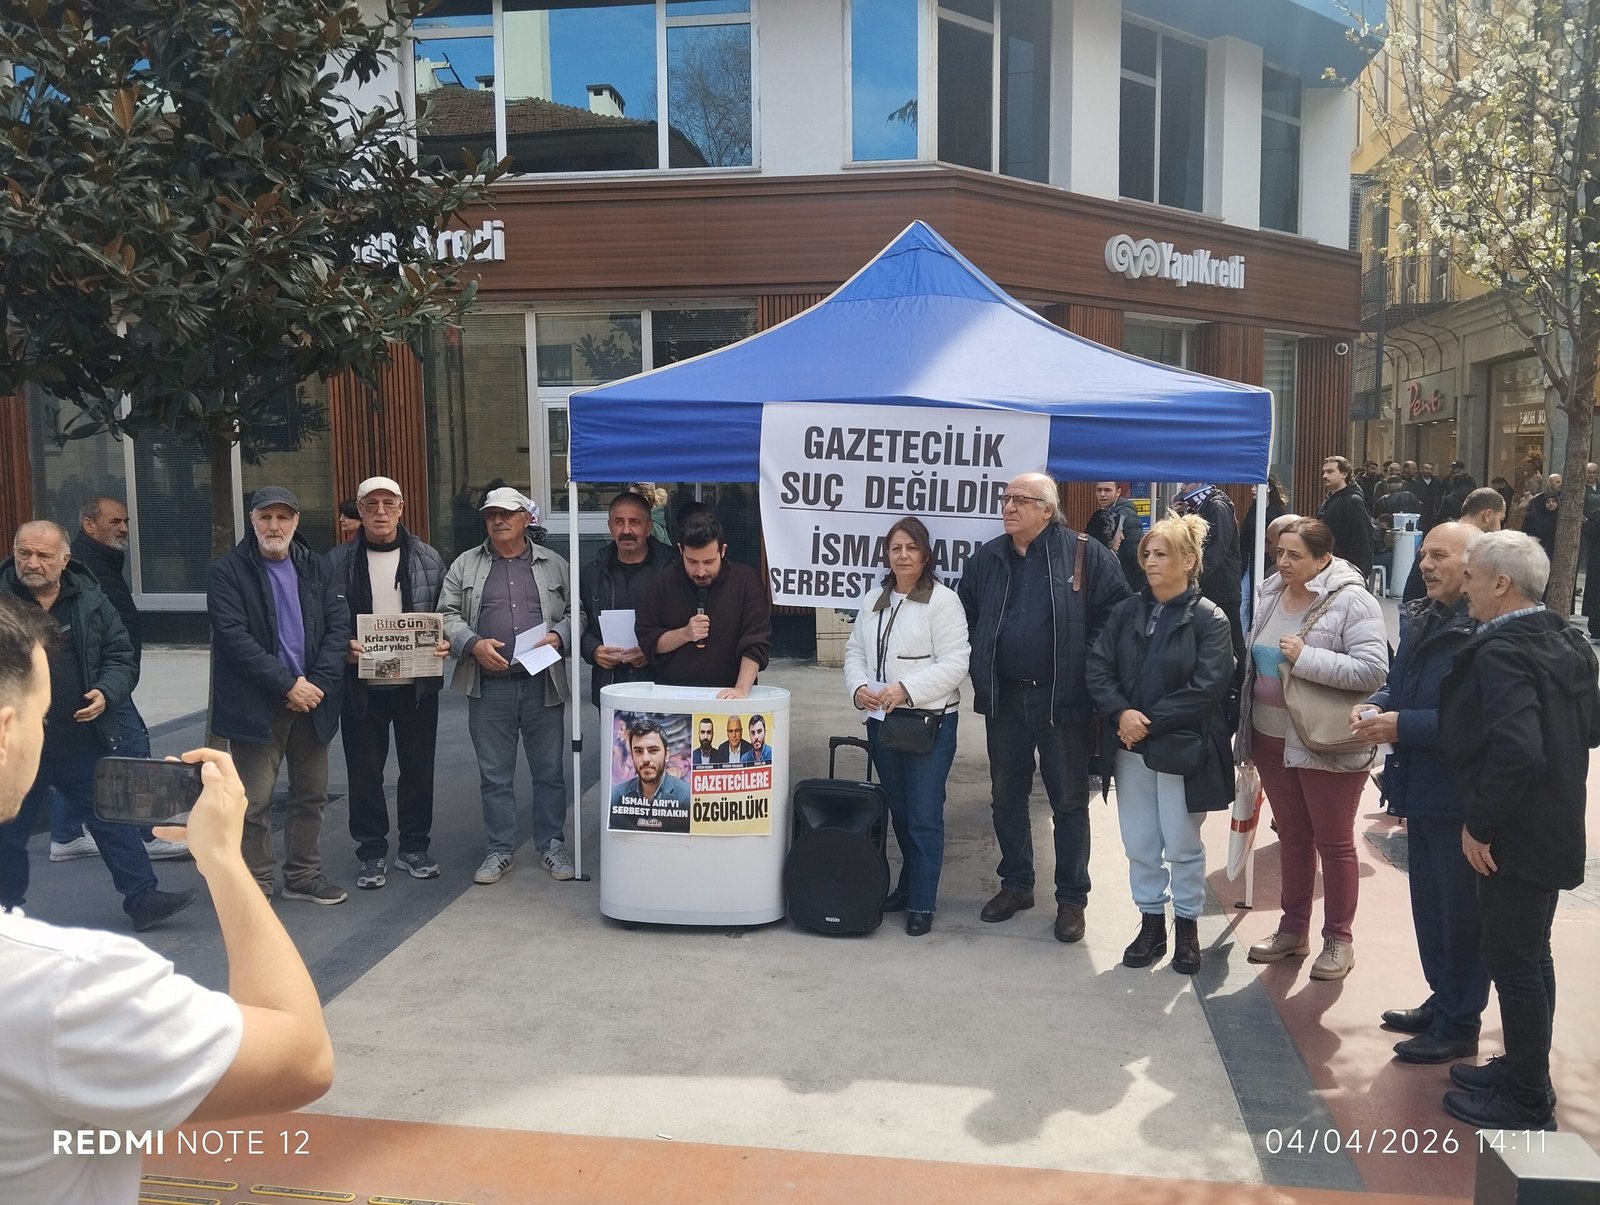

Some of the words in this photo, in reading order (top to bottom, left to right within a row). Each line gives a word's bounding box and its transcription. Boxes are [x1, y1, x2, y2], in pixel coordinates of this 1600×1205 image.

[1158, 242, 1245, 289] YapıKredi
[1407, 382, 1441, 416] Penti
[804, 424, 1005, 467] GAZETECİLİK
[780, 471, 844, 510] SUÇ
[771, 567, 876, 598] SERBEST
[364, 633, 384, 643] Kriz
[385, 634, 410, 644] savaş
[389, 643, 413, 653] yıkıcı
[694, 770, 769, 792] GAZETECİLERE
[612, 805, 651, 818] SERBEST
[652, 808, 689, 819] BIRAKIN
[622, 795, 650, 808] İSMAİL
[693, 795, 769, 822] ÖZGÜRLÜK!
